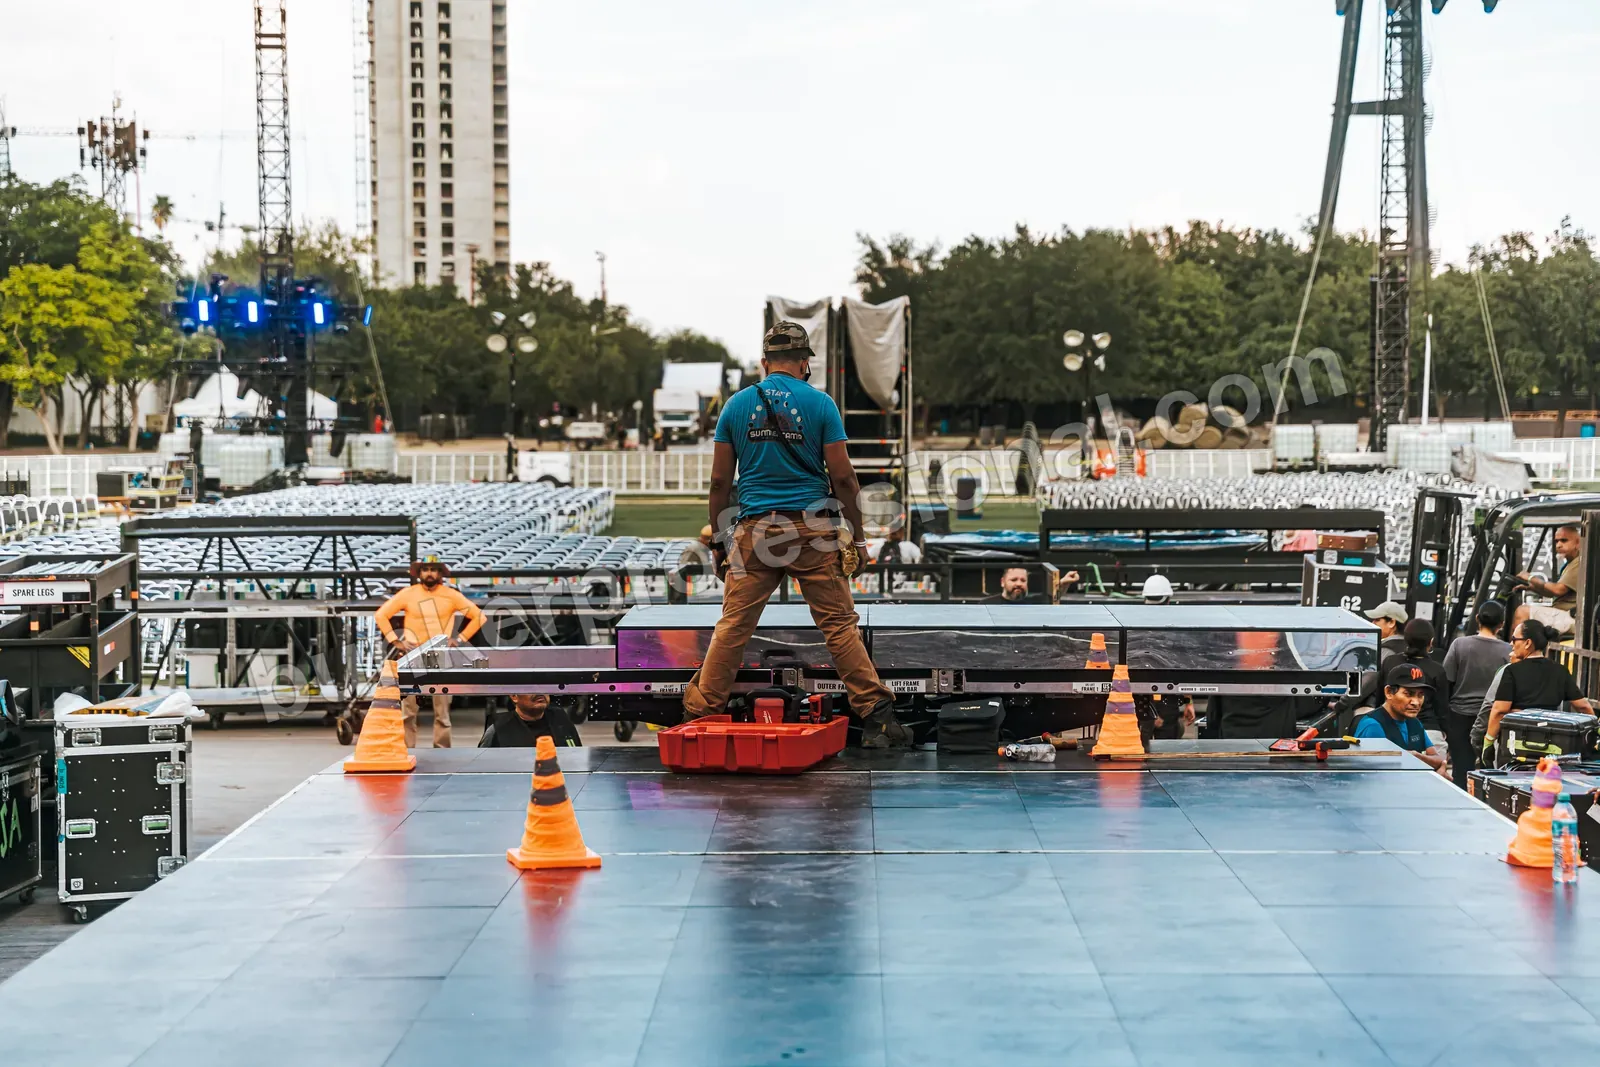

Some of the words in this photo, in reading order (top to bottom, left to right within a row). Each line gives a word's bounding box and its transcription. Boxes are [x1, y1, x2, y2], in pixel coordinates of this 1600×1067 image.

[750, 429, 778, 437] SUMME
[1420, 572, 1435, 583] 25
[12, 588, 36, 597] SPARE
[37, 588, 55, 597] LEGS
[817, 682, 837, 690] OUTER
[837, 683, 846, 691] FA
